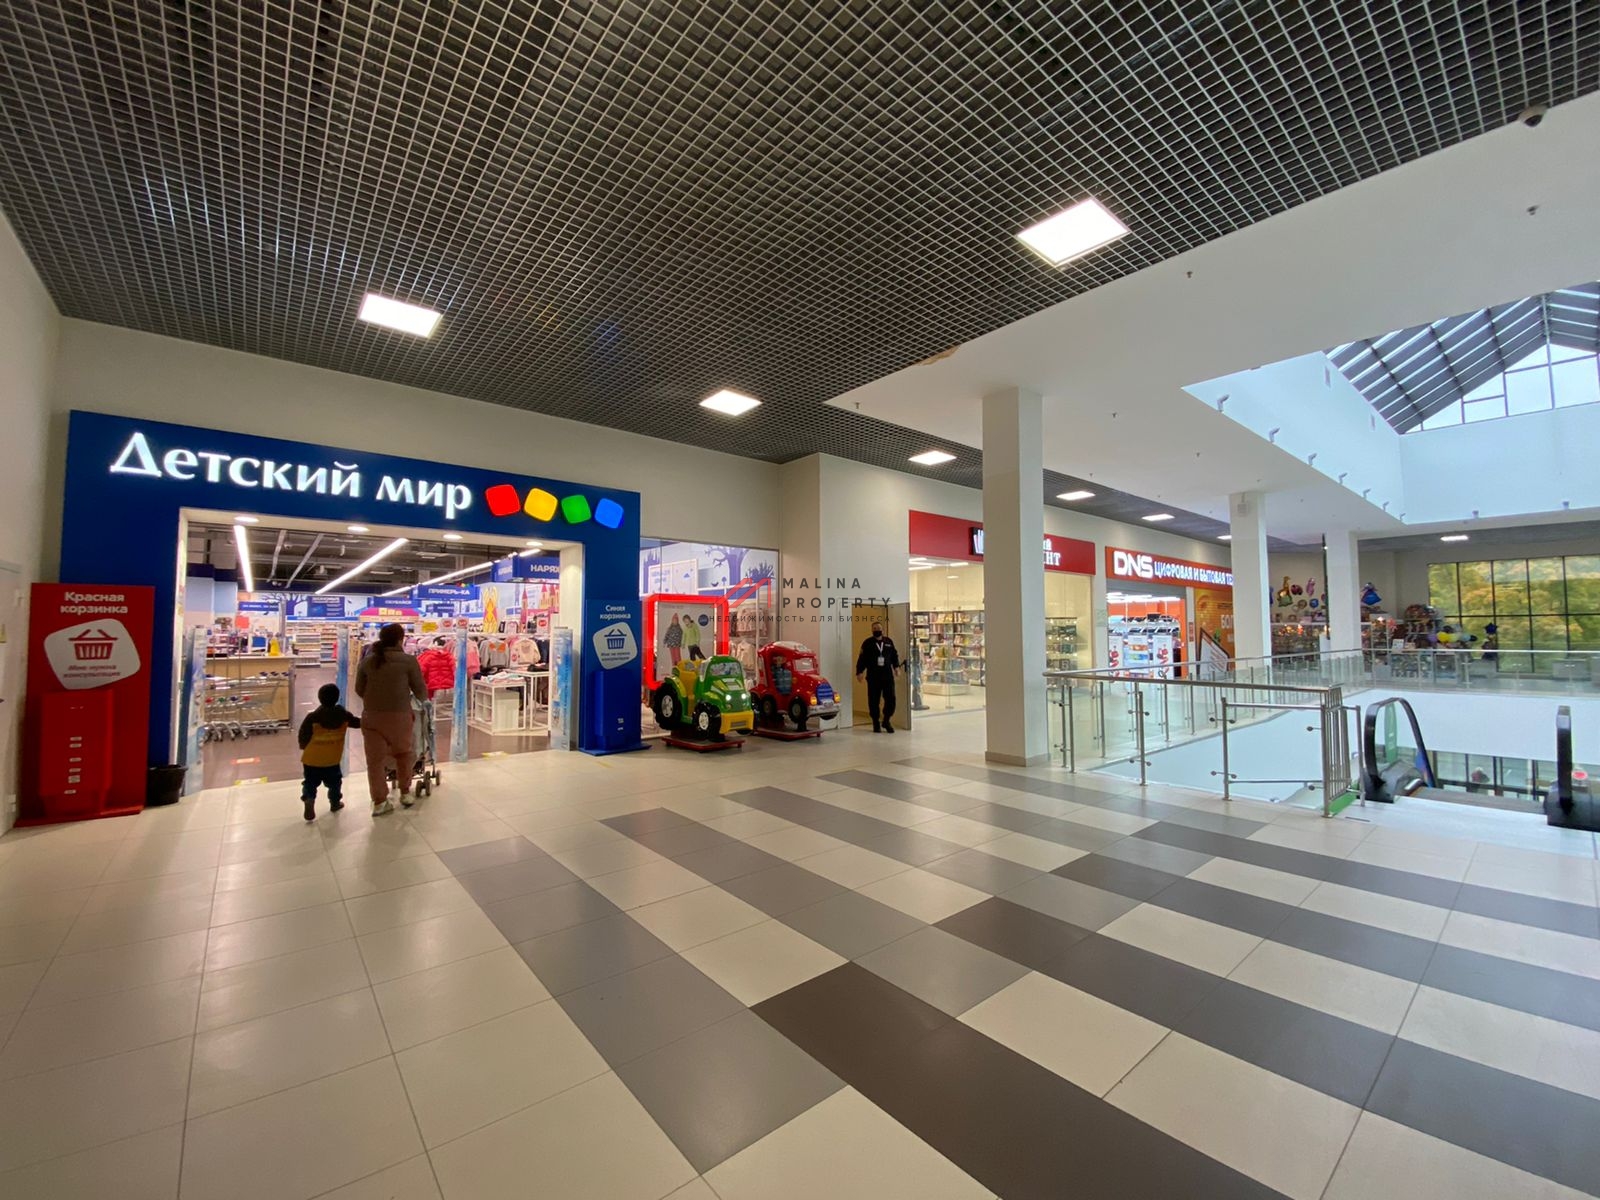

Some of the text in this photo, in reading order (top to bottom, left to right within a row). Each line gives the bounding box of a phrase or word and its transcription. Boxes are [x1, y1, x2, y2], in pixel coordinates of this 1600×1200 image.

[109, 432, 473, 520] Детский мир
[1113, 550, 1153, 579] DNS
[1154, 561, 1193, 580] ЦИФРОВАЯ
[1193, 567, 1199, 581] И
[1199, 569, 1226, 585] БЫТОВАЯ
[64, 591, 125, 603] Красная
[60, 604, 129, 616] корзинка
[605, 604, 626, 612] Синяя
[599, 613, 631, 621] корзинка
